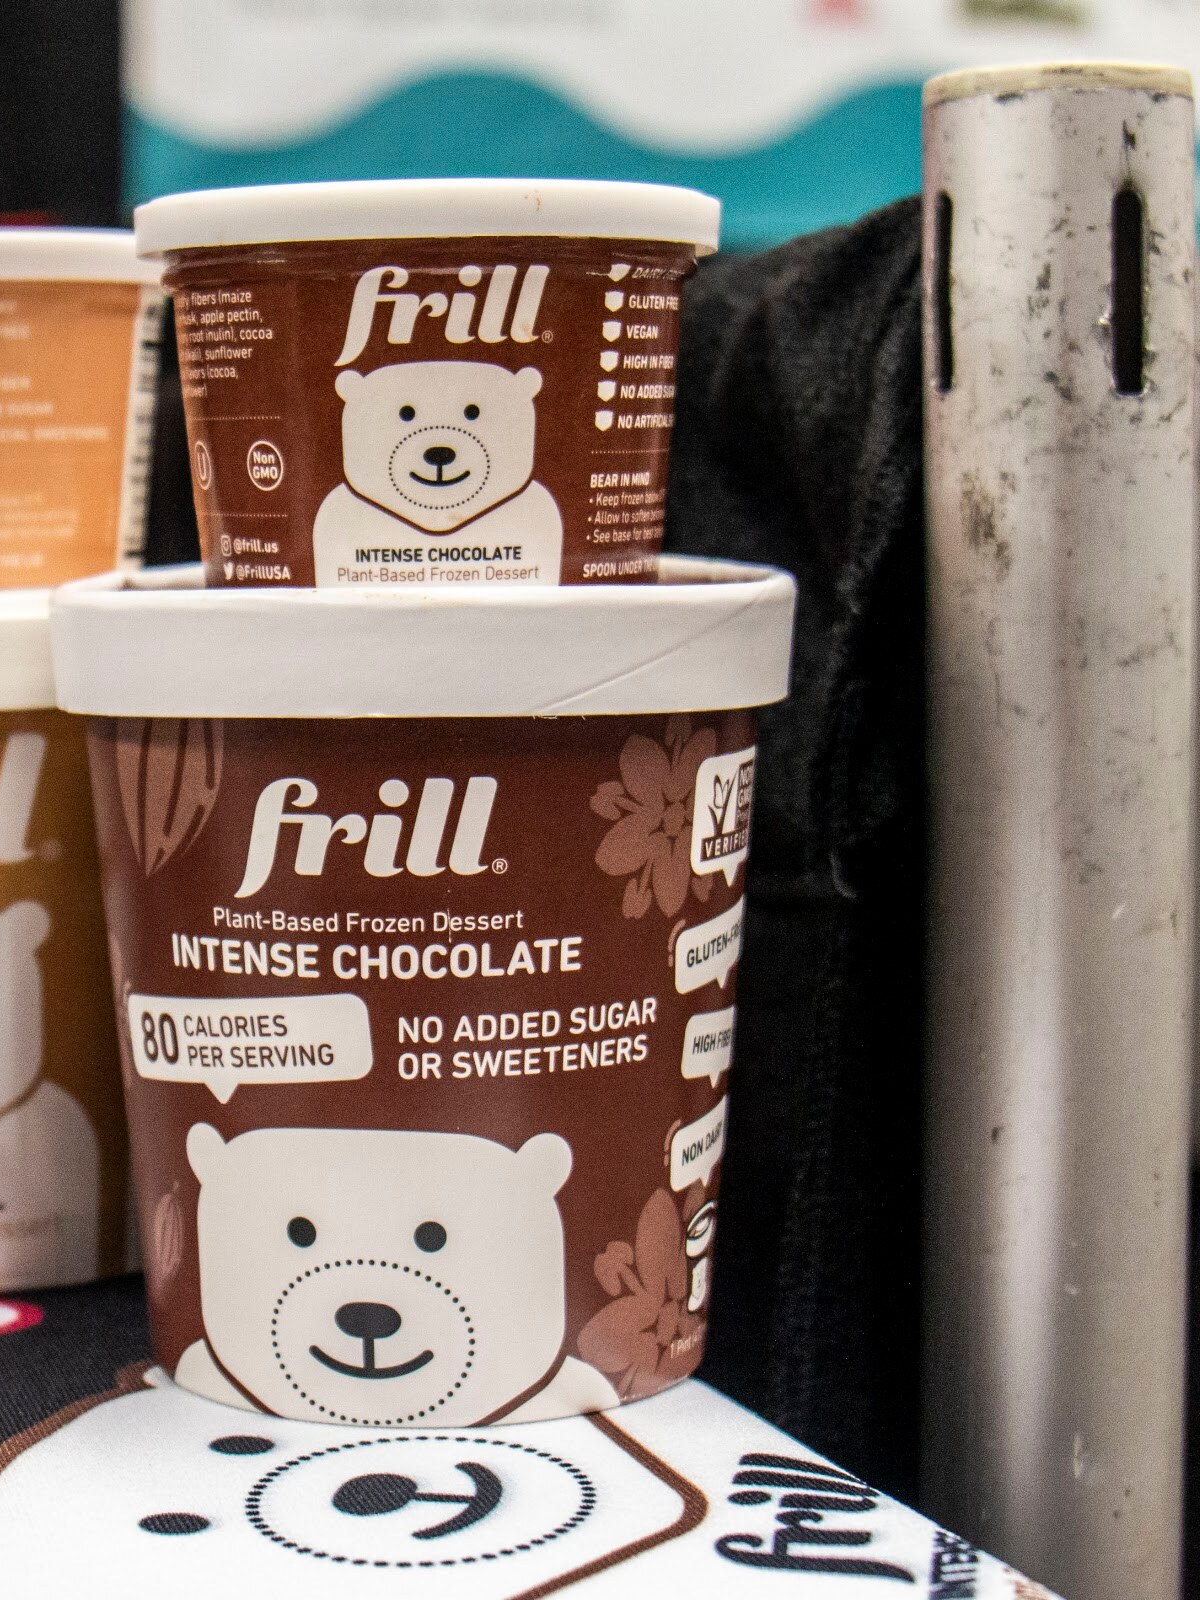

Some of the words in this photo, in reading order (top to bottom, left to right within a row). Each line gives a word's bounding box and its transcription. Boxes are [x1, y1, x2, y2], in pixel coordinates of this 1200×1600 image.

[191, 291, 216, 306] fibers
[629, 295, 664, 310] GLUTEN
[200, 309, 224, 326] apple
[227, 307, 263, 325] pectin,
[334, 264, 550, 367] frill
[240, 328, 273, 341] cocoa
[626, 325, 658, 339] VEGAN
[205, 345, 253, 360] sunflower
[623, 355, 647, 369] HIGH
[650, 355, 658, 369] IN
[620, 385, 635, 399] NO
[637, 384, 662, 399] ADDED
[618, 415, 633, 429] NO
[253, 451, 275, 464] Non
[253, 466, 278, 479] GMO
[590, 473, 618, 488] BEAR
[620, 473, 630, 486] IN
[631, 471, 650, 486] MIND
[596, 492, 619, 508] Keep
[621, 491, 643, 505] frozen
[594, 510, 620, 525] Allow
[622, 511, 630, 523] to
[592, 528, 610, 543] See
[612, 528, 631, 542] base
[234, 538, 279, 554] @frill.us
[355, 548, 423, 563] INTENSE
[428, 546, 522, 563] CHOCOLATE
[236, 565, 291, 580] @FrillUSA
[337, 566, 425, 583] Plant-Based
[430, 566, 480, 582] Frozen
[485, 564, 540, 581] Dessert
[583, 561, 617, 578] SPOON
[618, 560, 642, 576] UNDER
[233, 776, 498, 899] frill
[213, 906, 338, 933] Plant-Based
[346, 912, 425, 933] Frozen
[433, 909, 524, 932] Dessert
[686, 917, 742, 968] GLUTEN-FR
[171, 933, 320, 978] INTENSE
[332, 936, 583, 980] CHOCOLATE
[398, 1015, 443, 1044] NO
[453, 1010, 561, 1043] ADDED
[569, 997, 657, 1035] SUGAR
[141, 1010, 180, 1065] 80
[183, 1014, 288, 1038] CALORIES
[692, 1032, 715, 1056] HIGH
[187, 1045, 224, 1067] PER
[230, 1043, 335, 1068] SERVING
[398, 1052, 442, 1080] OR
[451, 1034, 648, 1079] SWEETENERS
[681, 1138, 704, 1167] NON
